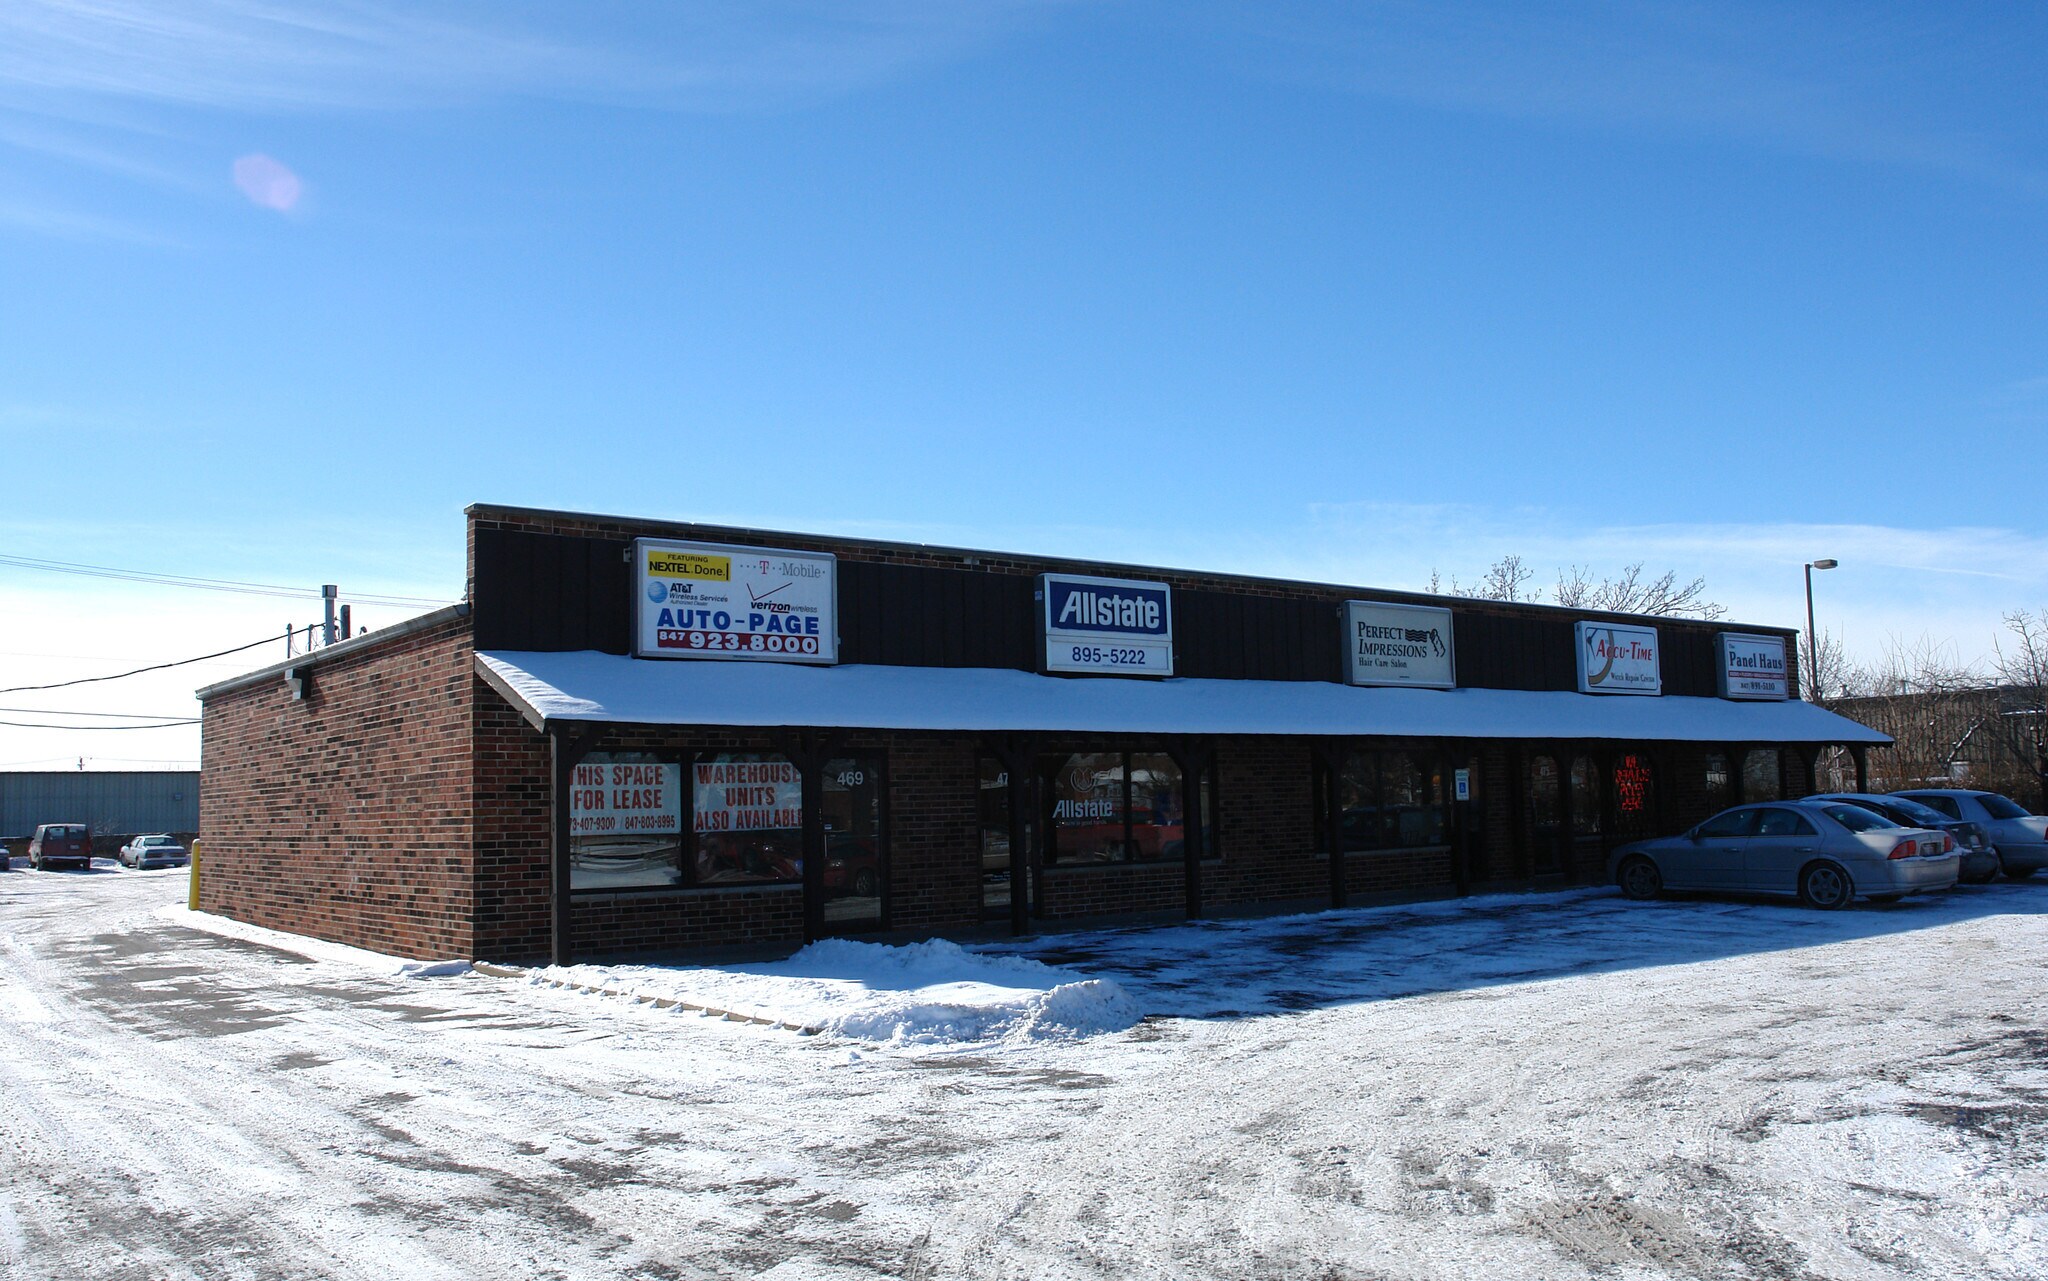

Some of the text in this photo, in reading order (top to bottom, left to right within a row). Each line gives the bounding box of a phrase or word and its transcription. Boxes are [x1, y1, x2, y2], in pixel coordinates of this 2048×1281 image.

[667, 554, 708, 563] FEATURING
[694, 565, 726, 577] Done.
[782, 562, 821, 578] Mobile
[669, 592, 729, 603] Wireless Services
[670, 583, 693, 593] AT&T
[750, 600, 818, 613] verizon wireless
[1059, 591, 1160, 629] Allstate
[1357, 621, 1403, 640] PERFECT
[659, 630, 817, 654] 847 923.8000
[1358, 639, 1428, 658] IMPRESSIONS
[1072, 646, 1145, 665] 895-5222
[1358, 657, 1408, 668] Hair Care Salon
[1729, 651, 1783, 669] Panel Haus
[612, 765, 664, 786] SPACE
[837, 771, 864, 787] 469
[574, 789, 662, 810] FOR LEASE
[725, 786, 775, 807] UNITS
[1052, 800, 1113, 819] Allstate
[695, 810, 729, 830] ALSO
